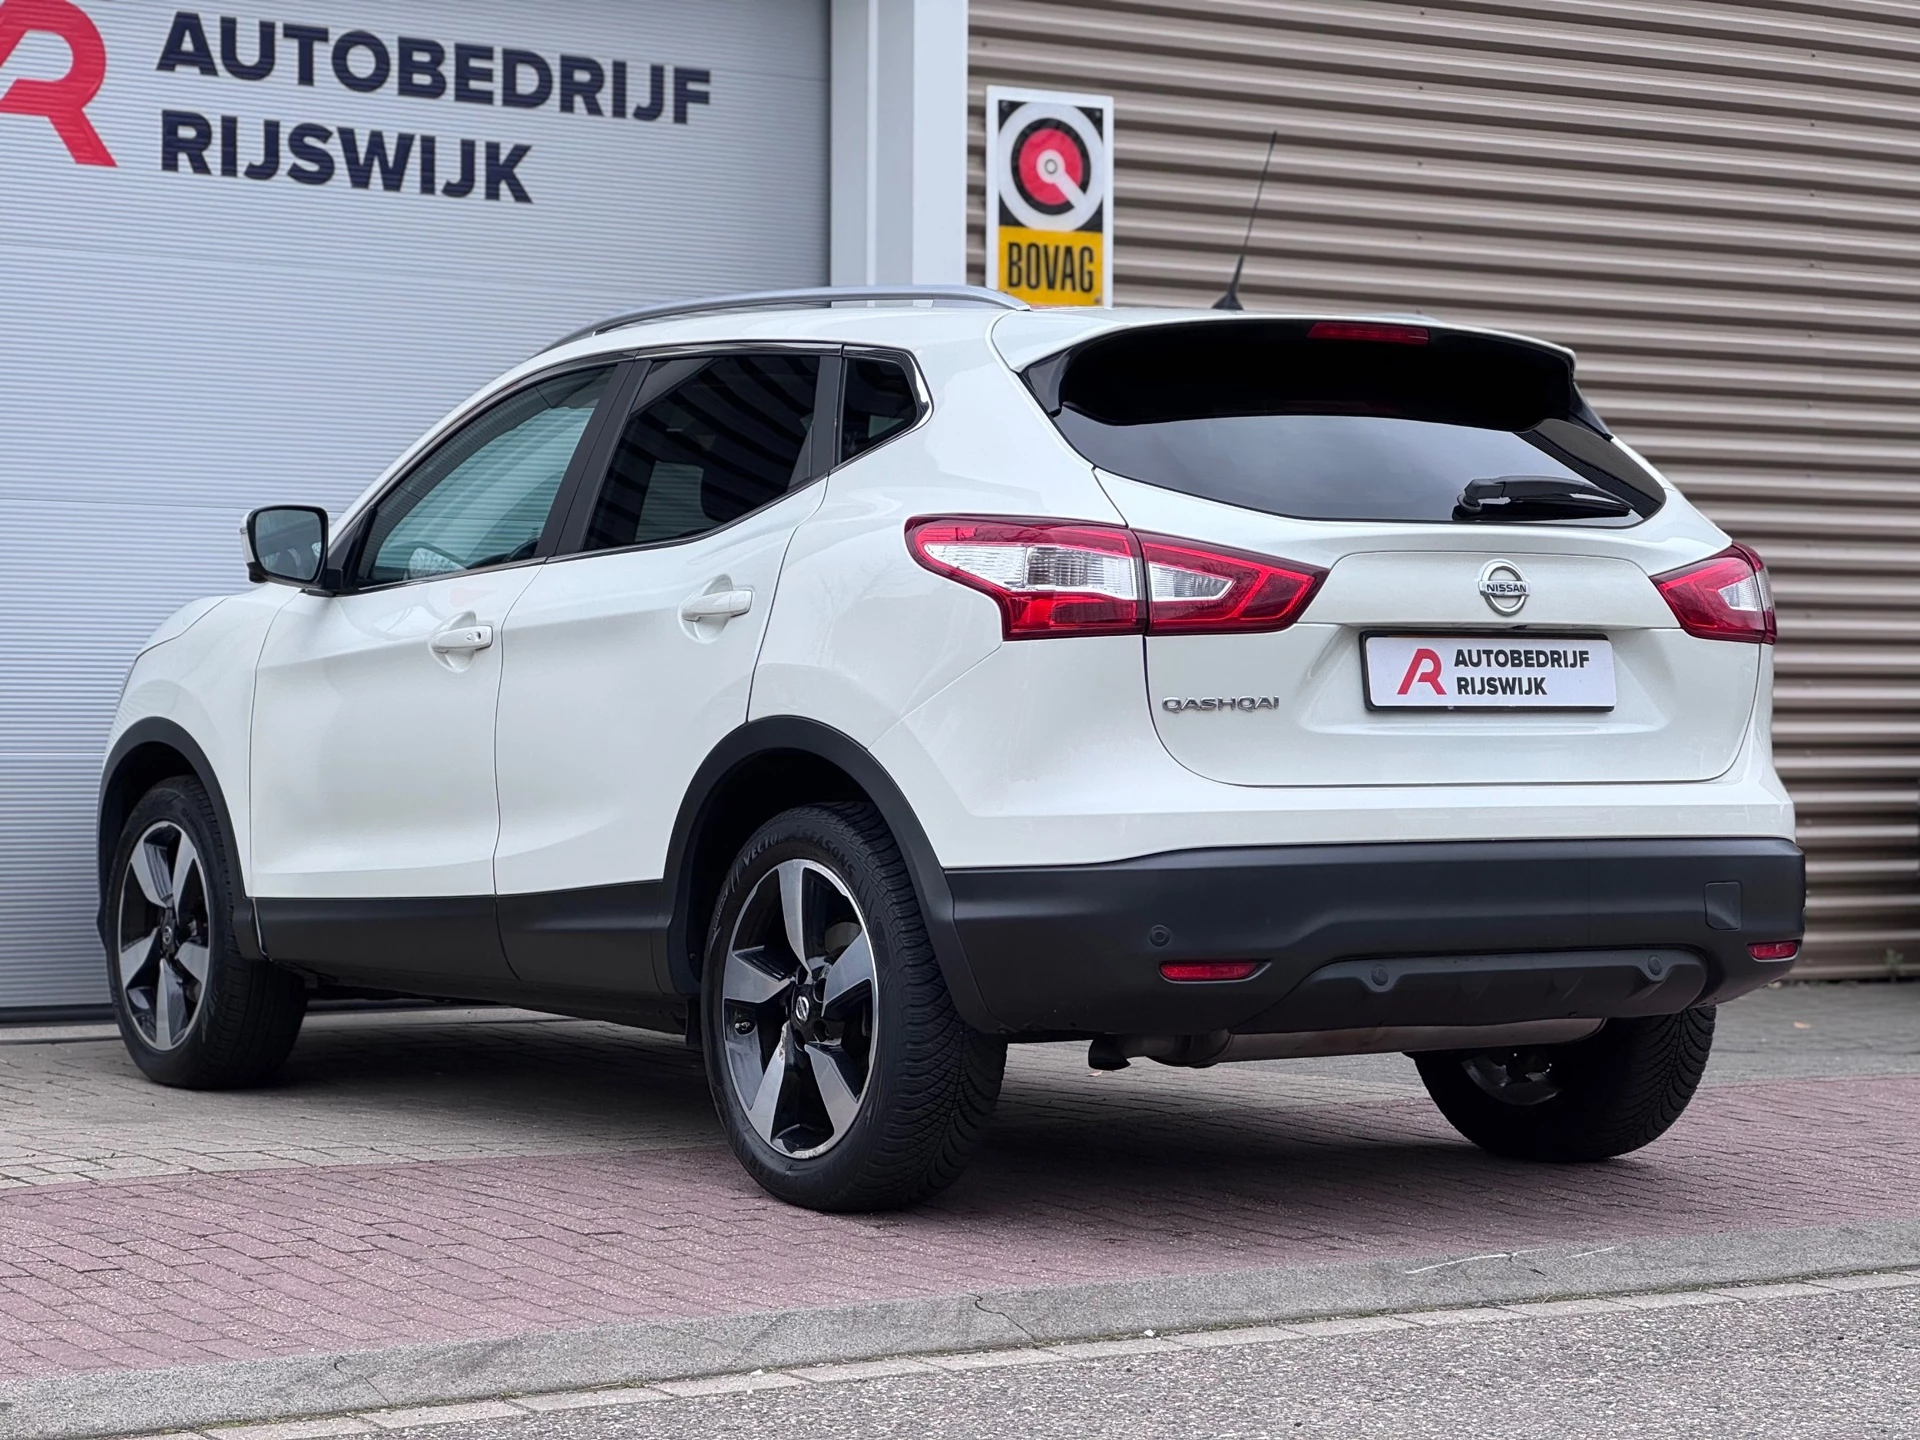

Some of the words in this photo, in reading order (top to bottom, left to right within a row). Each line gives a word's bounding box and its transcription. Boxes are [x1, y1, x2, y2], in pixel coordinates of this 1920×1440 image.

[156, 11, 711, 125] AUTOBEDRIJF
[161, 109, 534, 205] RIJSWIJK
[1007, 241, 1095, 293] BOVAG
[1486, 583, 1527, 593] NISSAN
[1453, 648, 1590, 669] AUTOBEDRIJF
[1456, 676, 1548, 696] RIJSWIJK
[1161, 695, 1280, 714] QASHQAI
